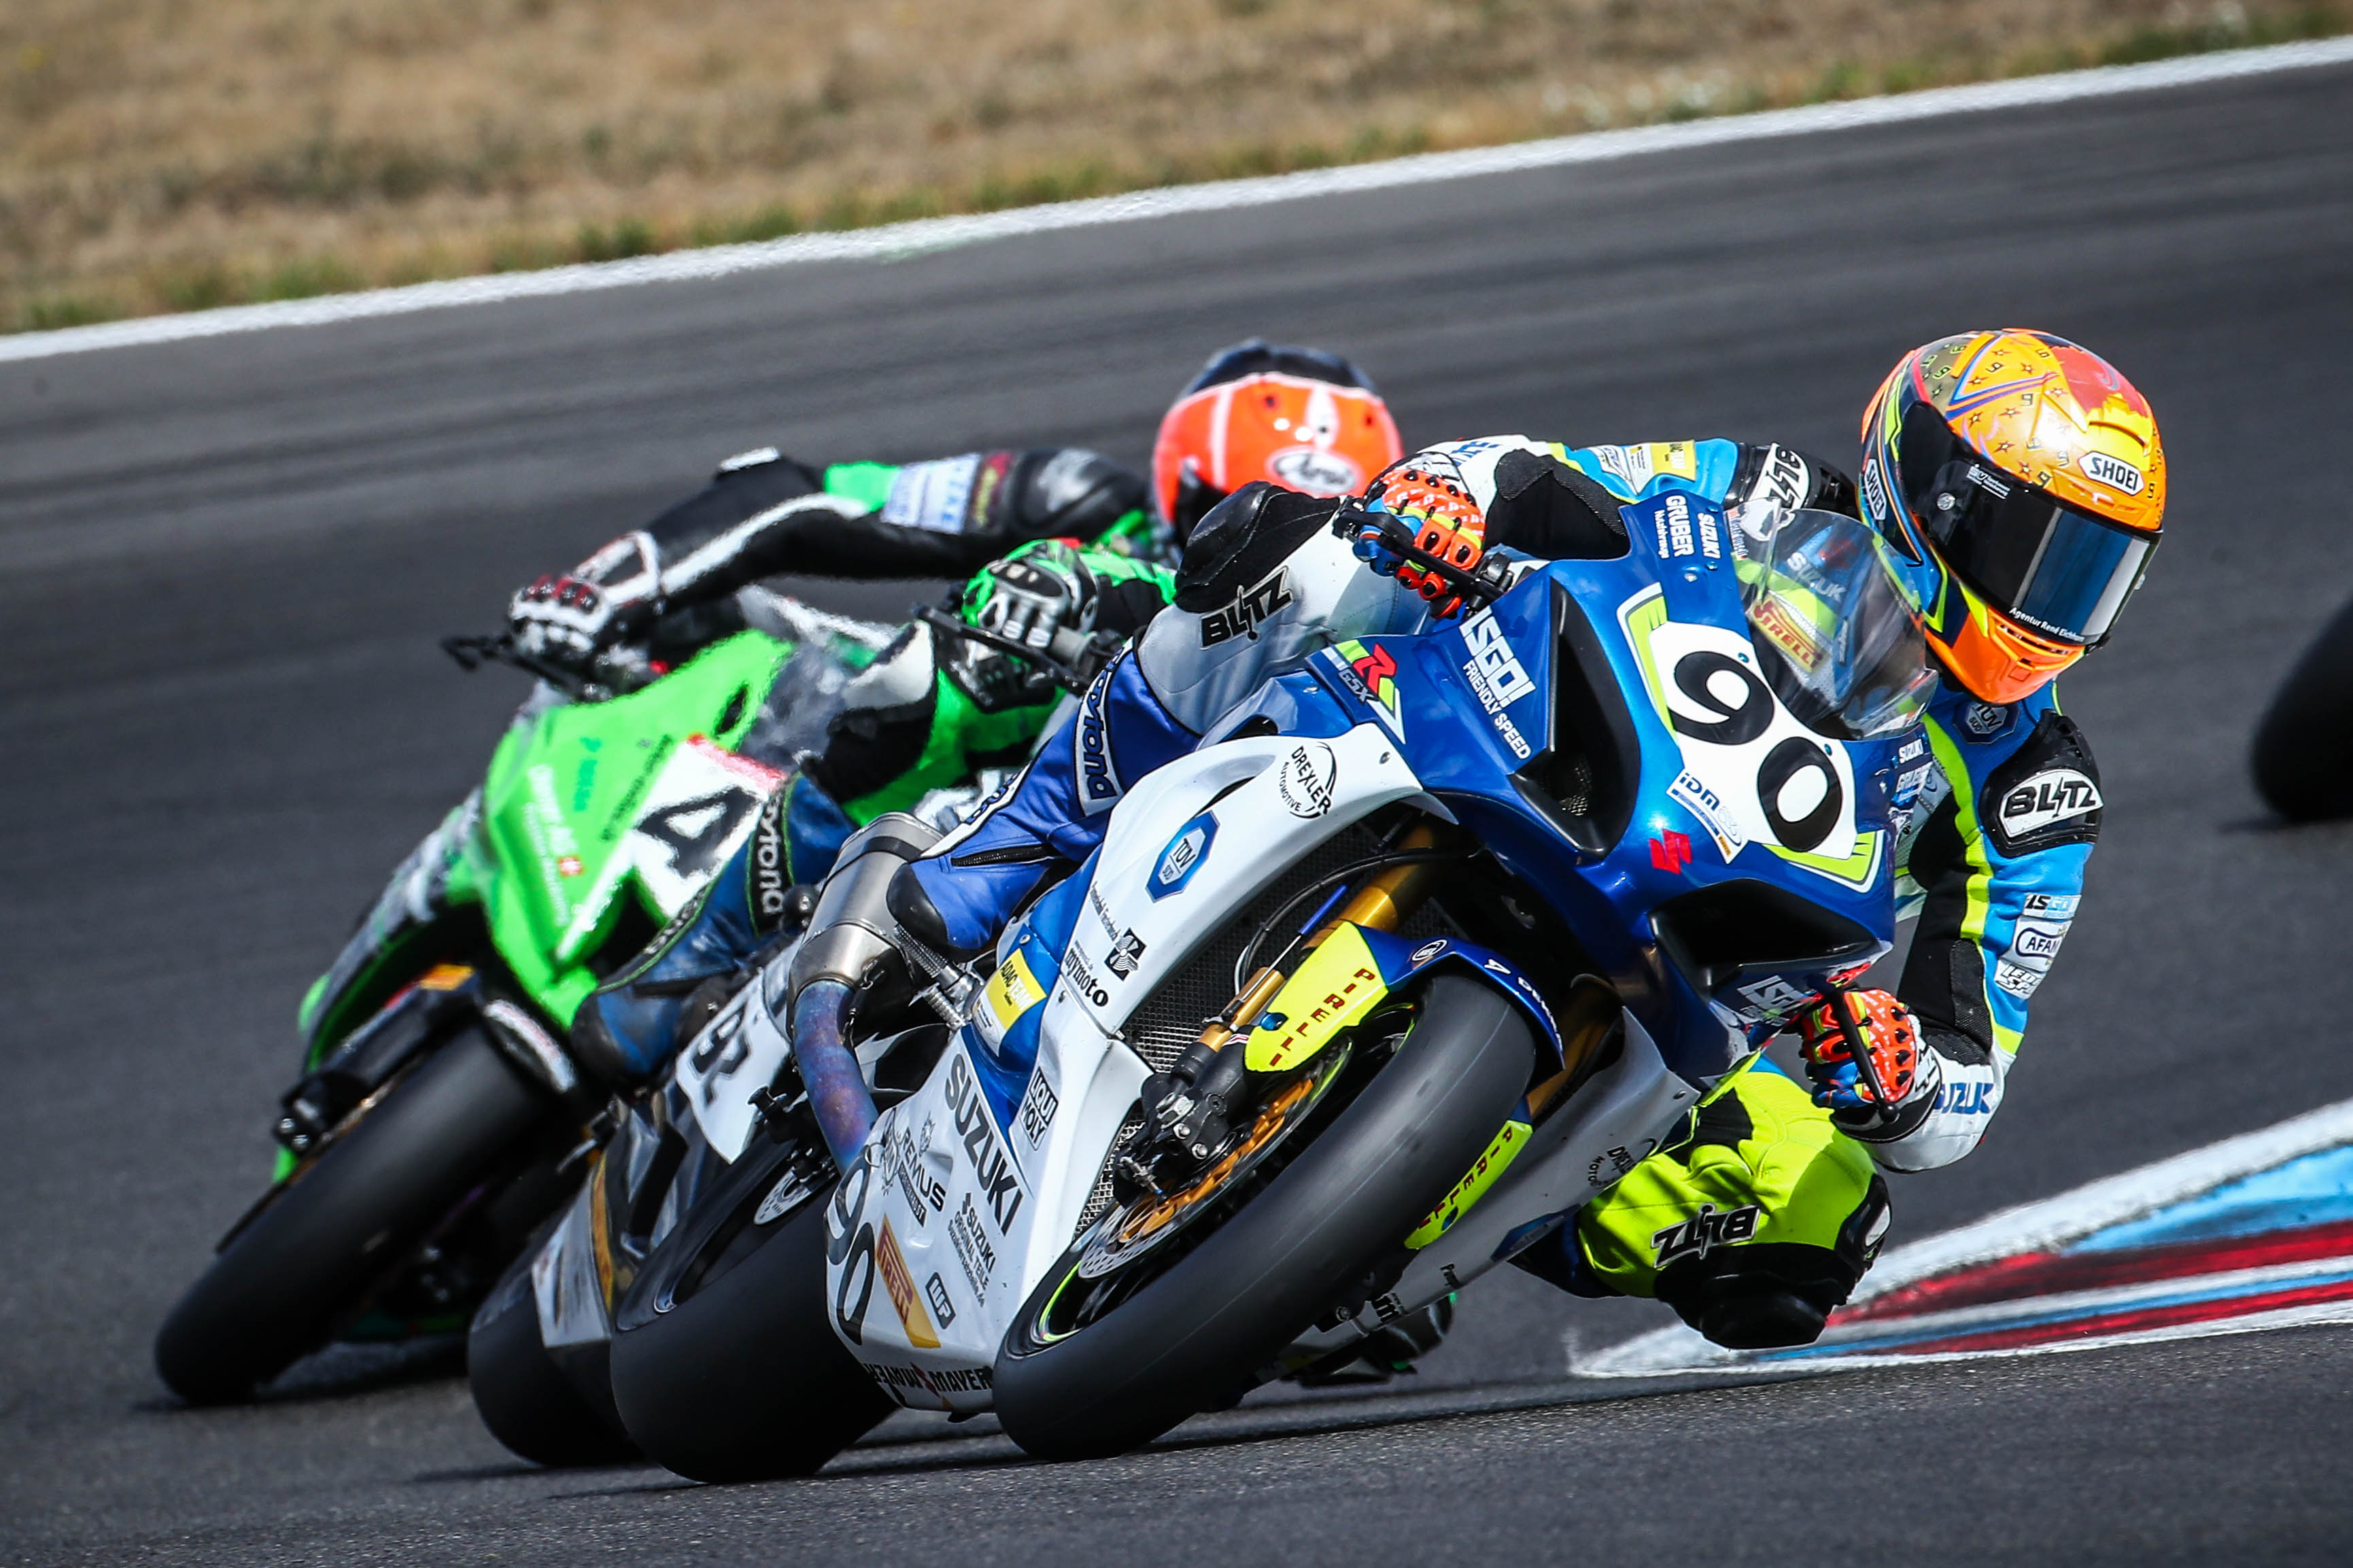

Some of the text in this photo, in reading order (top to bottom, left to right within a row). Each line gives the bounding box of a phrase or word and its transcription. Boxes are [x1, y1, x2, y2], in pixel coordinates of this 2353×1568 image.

[1866, 463, 1885, 517] SHOEI
[2091, 457, 2139, 491] SHOEI
[1666, 495, 1695, 557] GRUBER
[1697, 512, 1721, 559] SUZUKI
[1201, 568, 1292, 649] BLITZ
[1753, 599, 1823, 669] PIRELLI
[2009, 607, 2044, 628] Agentur
[1338, 668, 1375, 703] GSX
[1462, 661, 1532, 761] FRIENDLY SPEED
[1291, 746, 1332, 815] DREXLER
[1670, 650, 1842, 853] 90
[1279, 761, 1302, 812] AUTOMOTIVE
[2004, 778, 2096, 818] BLITZ
[757, 795, 785, 914] ytona
[1000, 960, 1018, 988] ADAC
[1064, 947, 1109, 1007] mymoto
[1270, 968, 1376, 1066] PIRELLI
[1019, 1102, 1046, 1143] MOLY
[1031, 1071, 1059, 1120] LIQUI
[901, 1126, 946, 1213] REMUS
[945, 1053, 1024, 1236] SUZUKI
[955, 1210, 990, 1291] ORIGINAL TEILE
[967, 1206, 996, 1274] SUZUKI
[877, 1223, 914, 1325] PIRELLI
